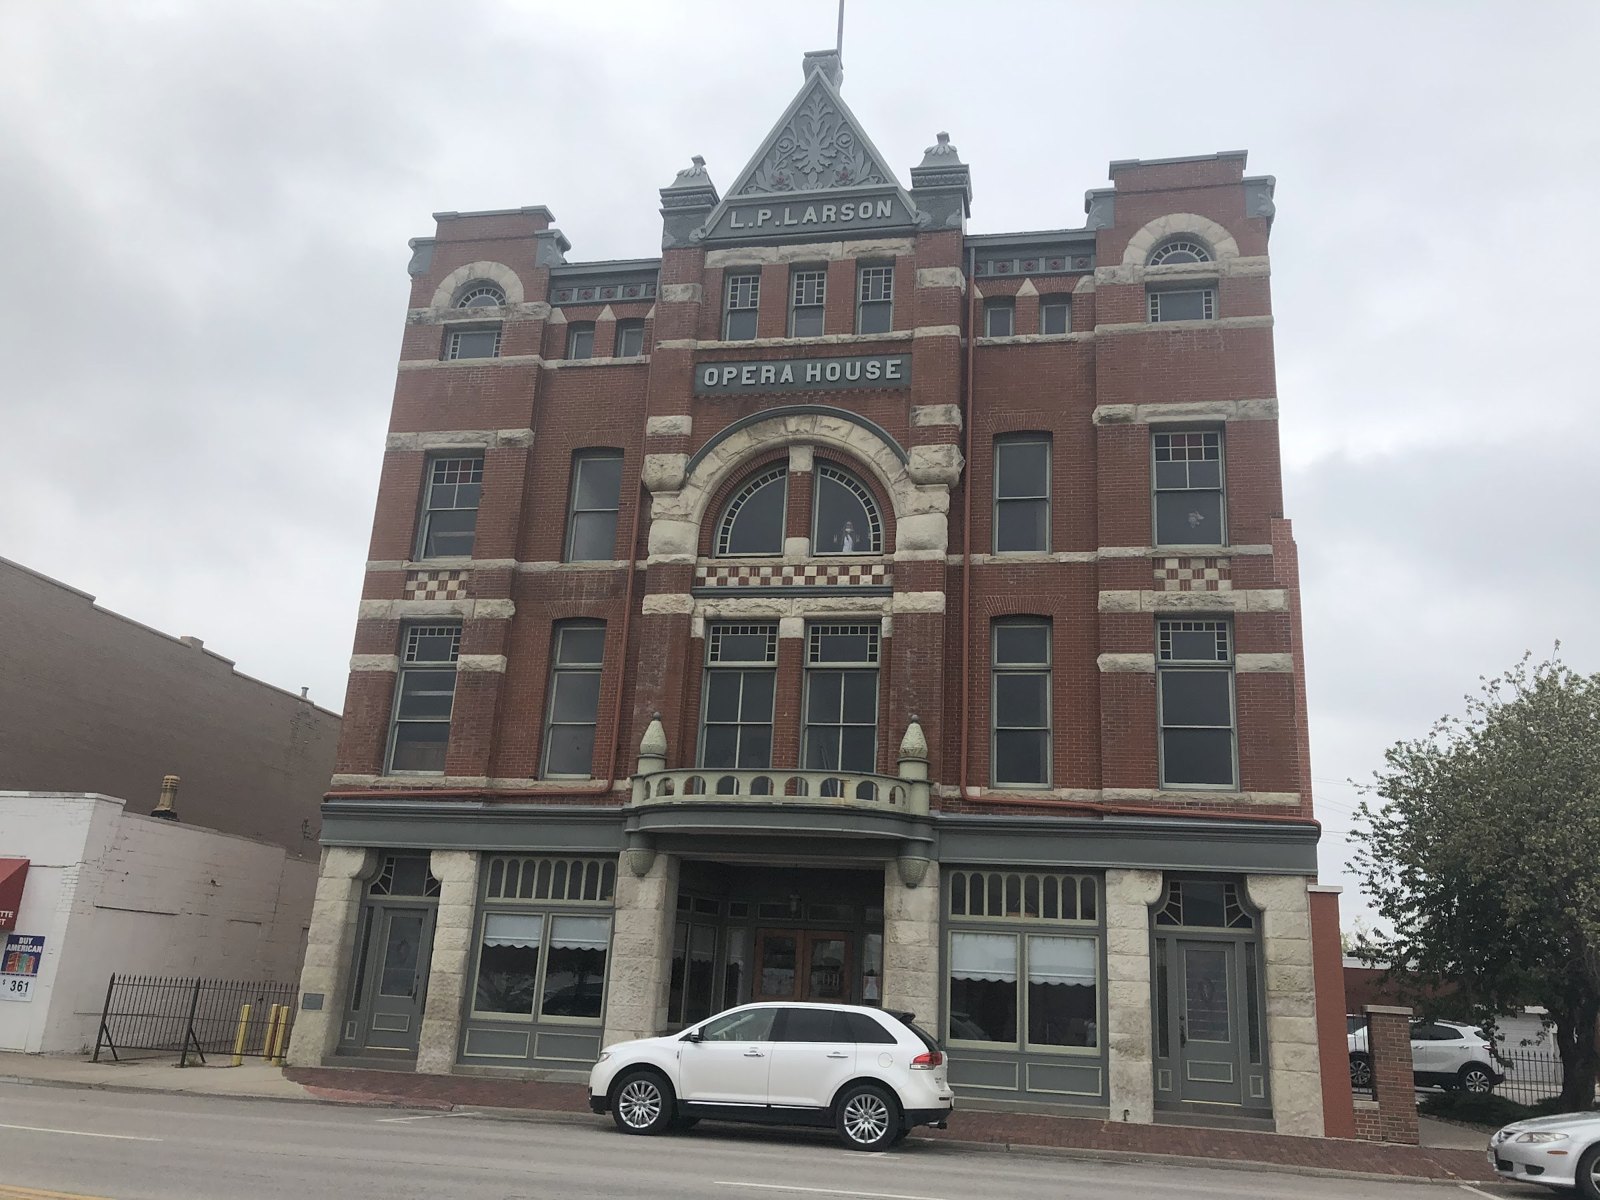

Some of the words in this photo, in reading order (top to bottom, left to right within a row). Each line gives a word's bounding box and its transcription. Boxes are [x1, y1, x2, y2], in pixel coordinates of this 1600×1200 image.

[704, 364, 794, 386] OPERA
[806, 359, 902, 382] HOUSE
[18, 937, 34, 945] BUY
[6, 944, 43, 953] AMERICAN
